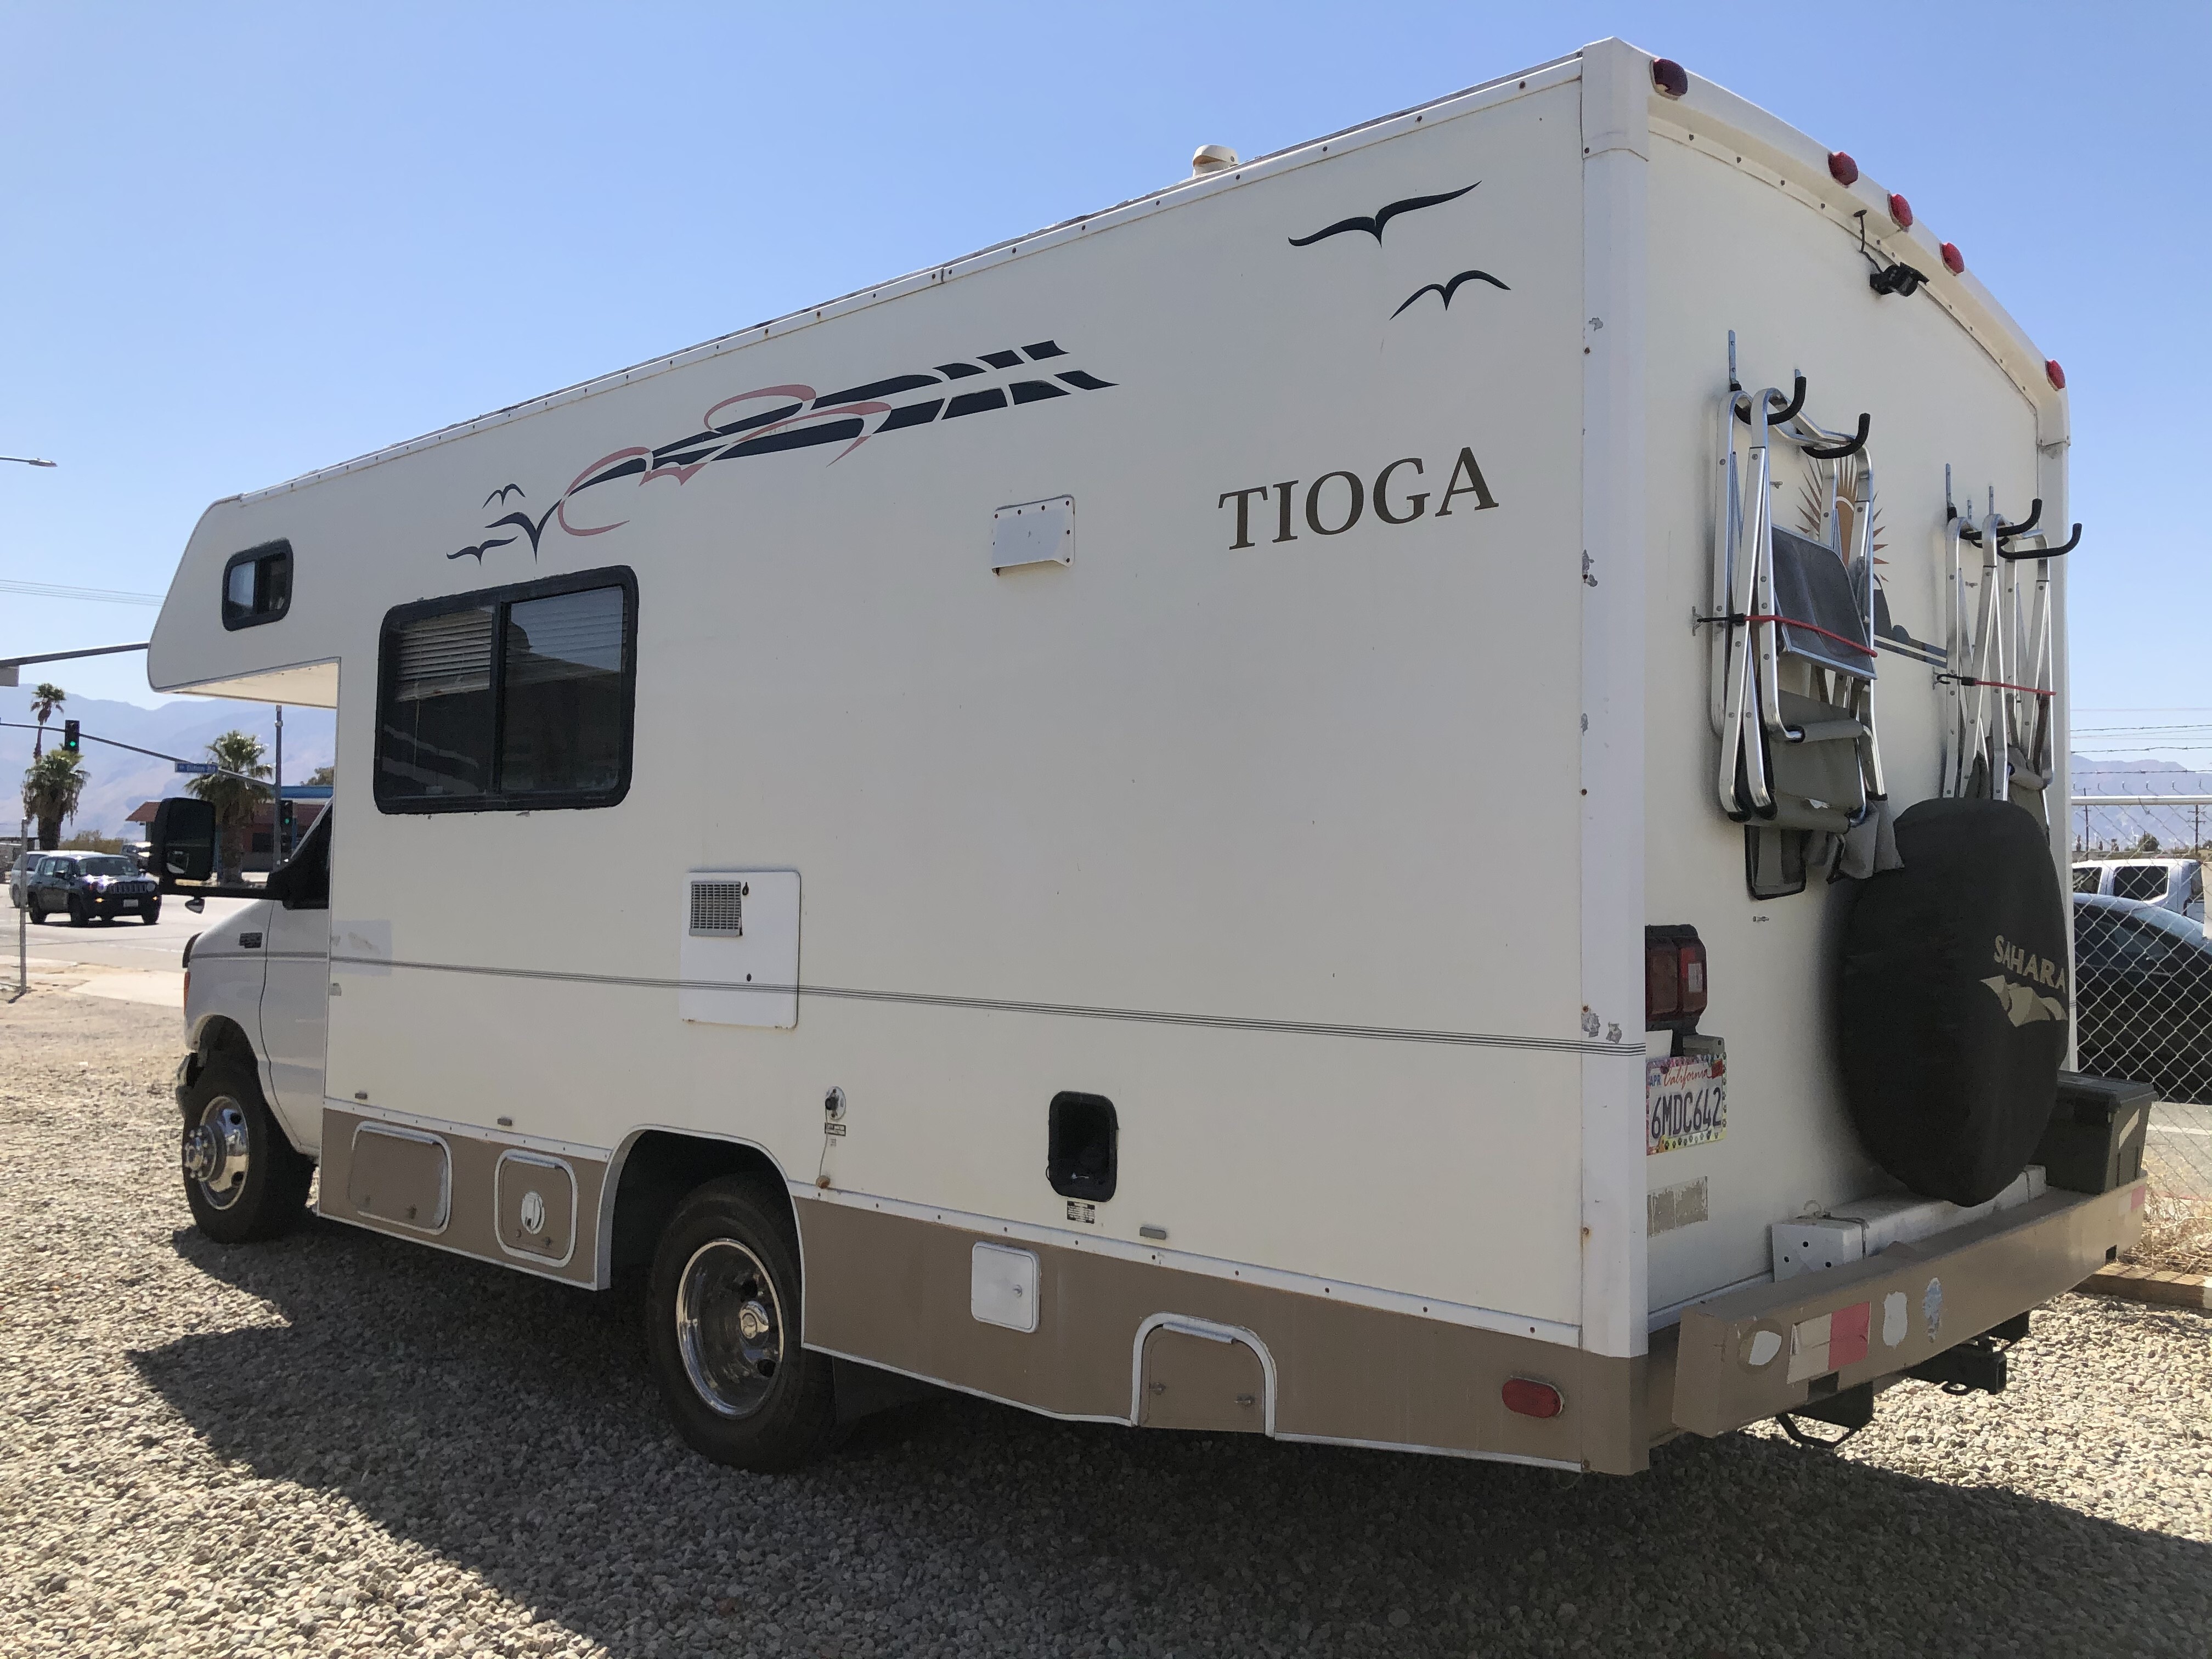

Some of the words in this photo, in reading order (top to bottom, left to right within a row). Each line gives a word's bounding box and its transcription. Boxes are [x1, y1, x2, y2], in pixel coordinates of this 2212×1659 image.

[1218, 447, 1499, 550] TIOGA
[1993, 934, 2066, 994] SAHARA
[1649, 1074, 1661, 1087] APR
[1663, 1064, 1713, 1091] California
[1651, 1087, 1722, 1139] 6MDC642
